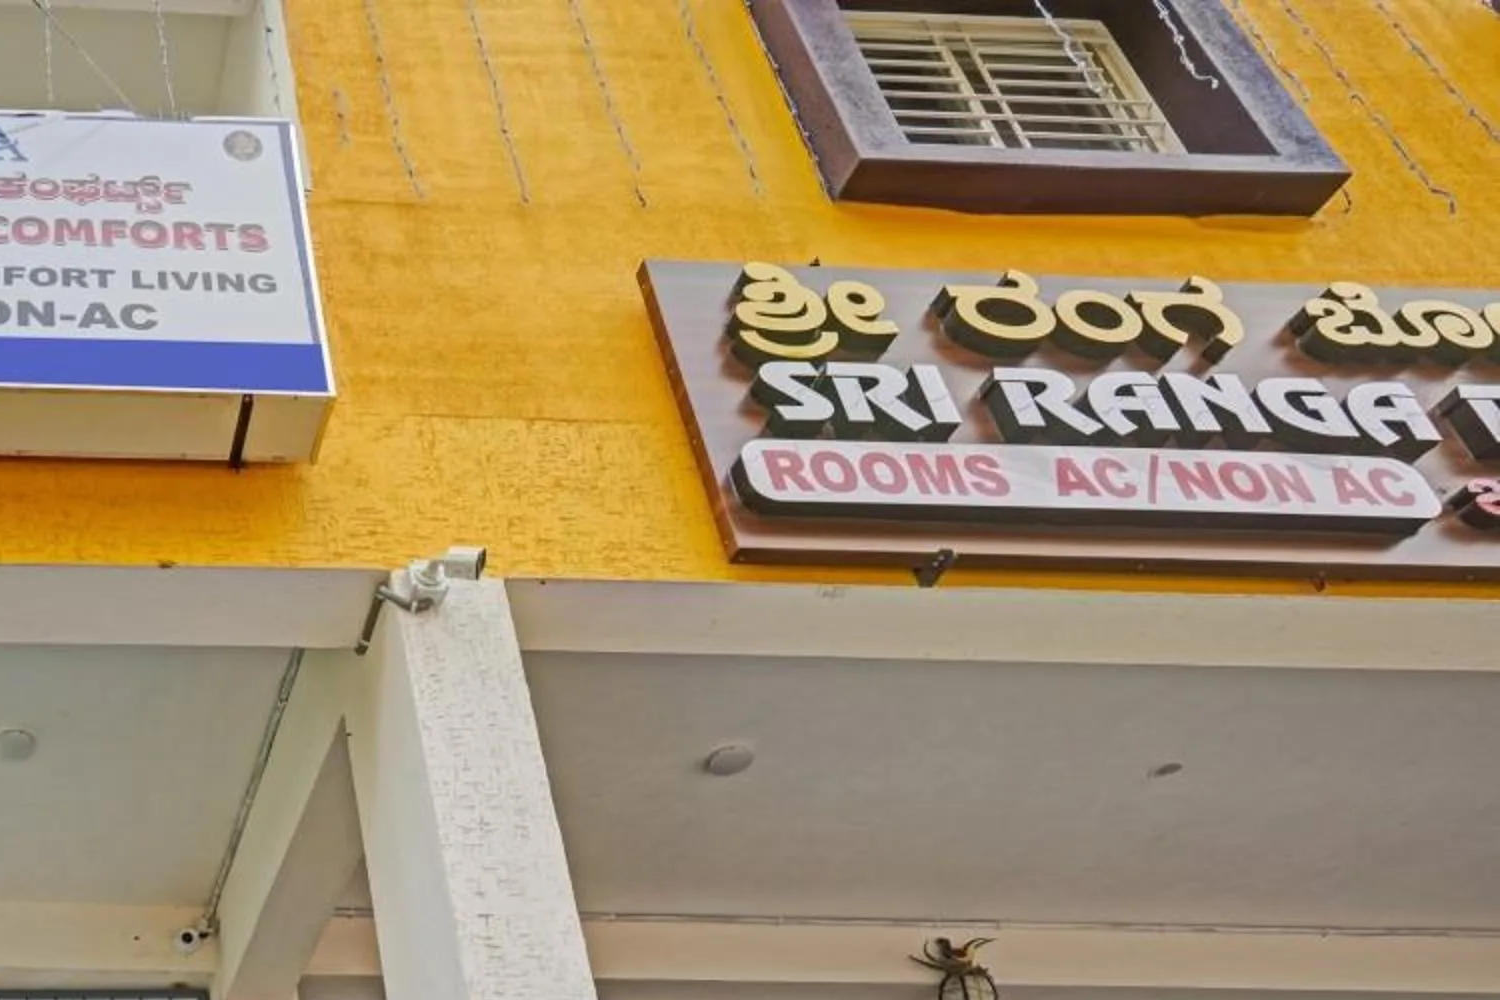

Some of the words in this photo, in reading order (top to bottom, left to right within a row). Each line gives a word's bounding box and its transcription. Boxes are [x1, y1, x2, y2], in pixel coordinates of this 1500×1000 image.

[131, 270, 277, 294] LIVING
[735, 261, 898, 358] ಶ್ರೀ
[942, 269, 1243, 349] ರಂಗ
[757, 361, 962, 430] SRI
[990, 366, 1443, 447] RANGA
[761, 448, 1012, 498] ROOMS
[1332, 465, 1416, 507] AC
